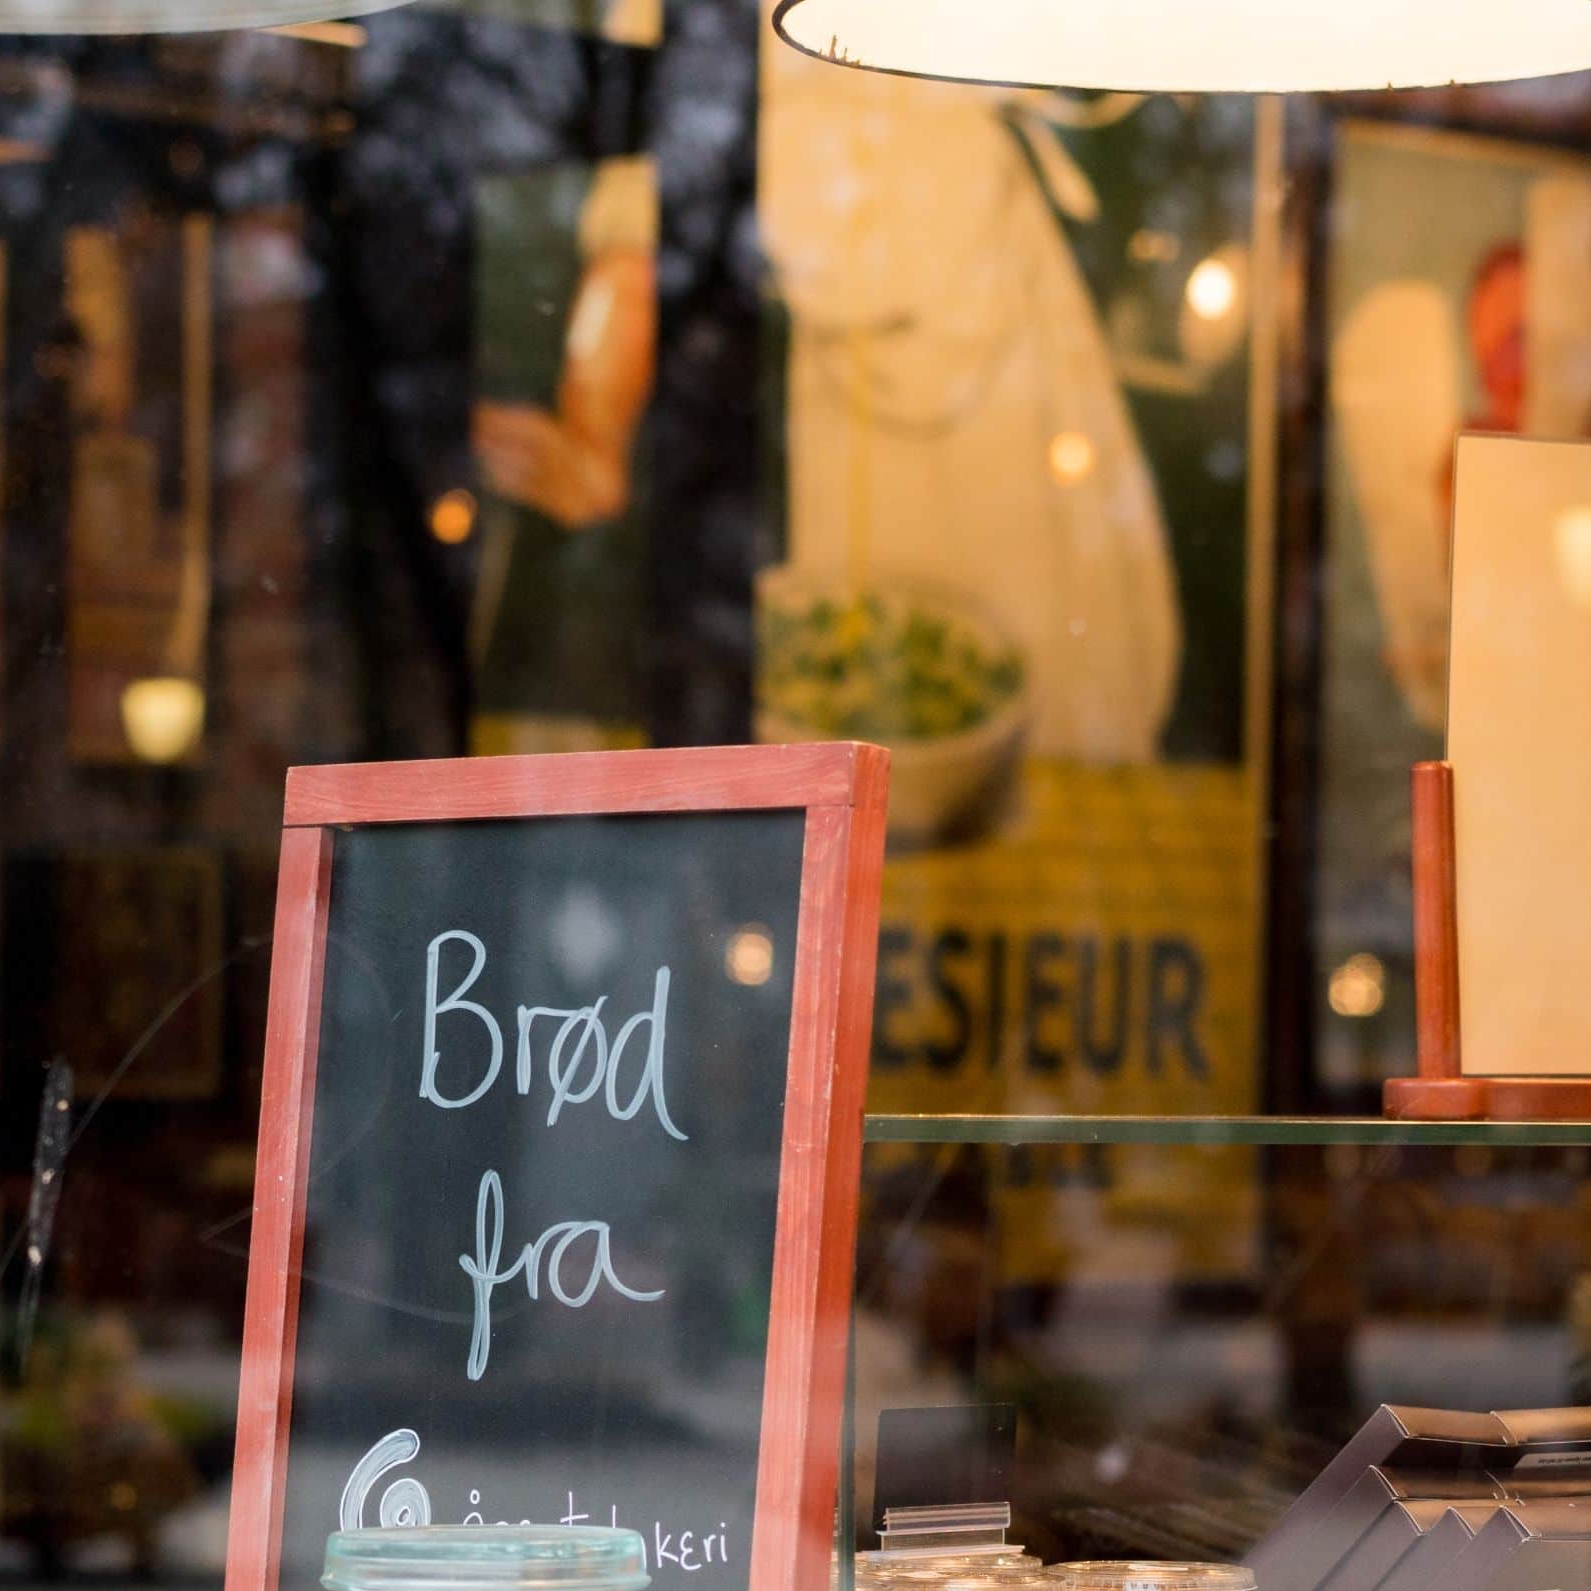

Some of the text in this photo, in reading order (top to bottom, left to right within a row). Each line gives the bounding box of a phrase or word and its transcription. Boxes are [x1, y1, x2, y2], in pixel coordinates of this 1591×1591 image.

[419, 929, 689, 1141] Brød
[458, 1168, 667, 1382] fra
[611, 1504, 730, 1572] keri
